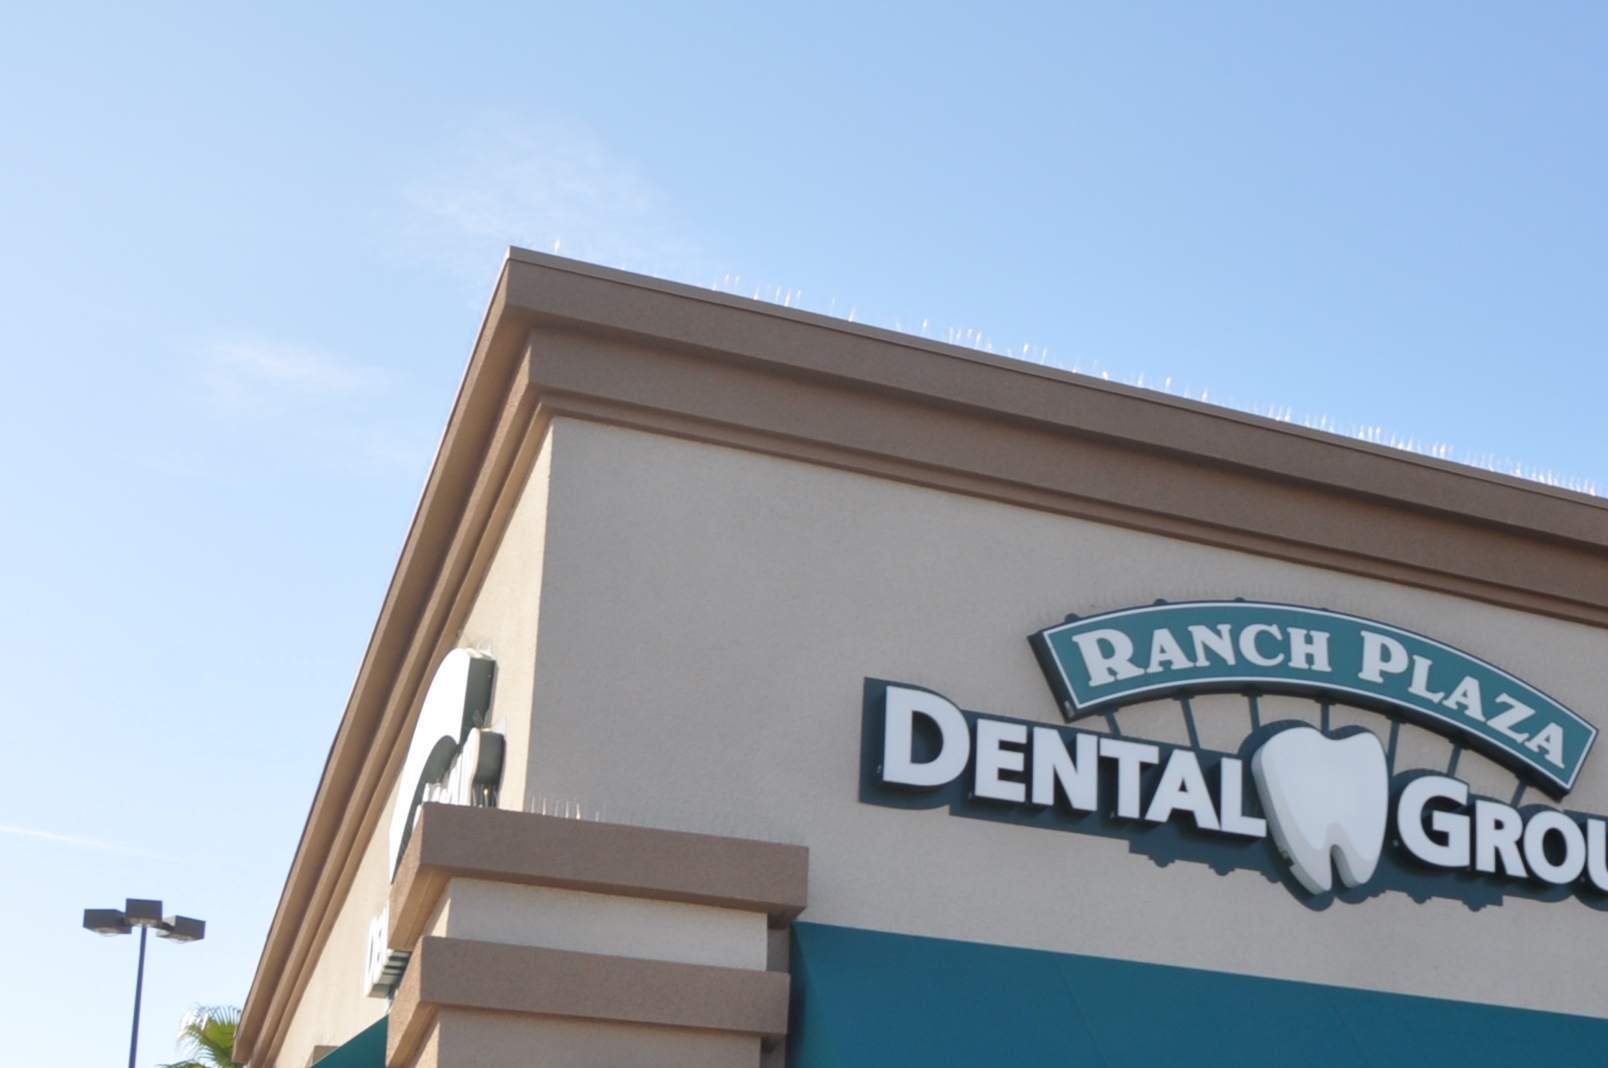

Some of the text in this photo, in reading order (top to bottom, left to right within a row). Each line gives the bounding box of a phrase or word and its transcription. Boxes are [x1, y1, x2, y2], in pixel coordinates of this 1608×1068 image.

[883, 686, 1268, 838] DENTAL
[1072, 622, 1566, 770] RANCH PLAZA
